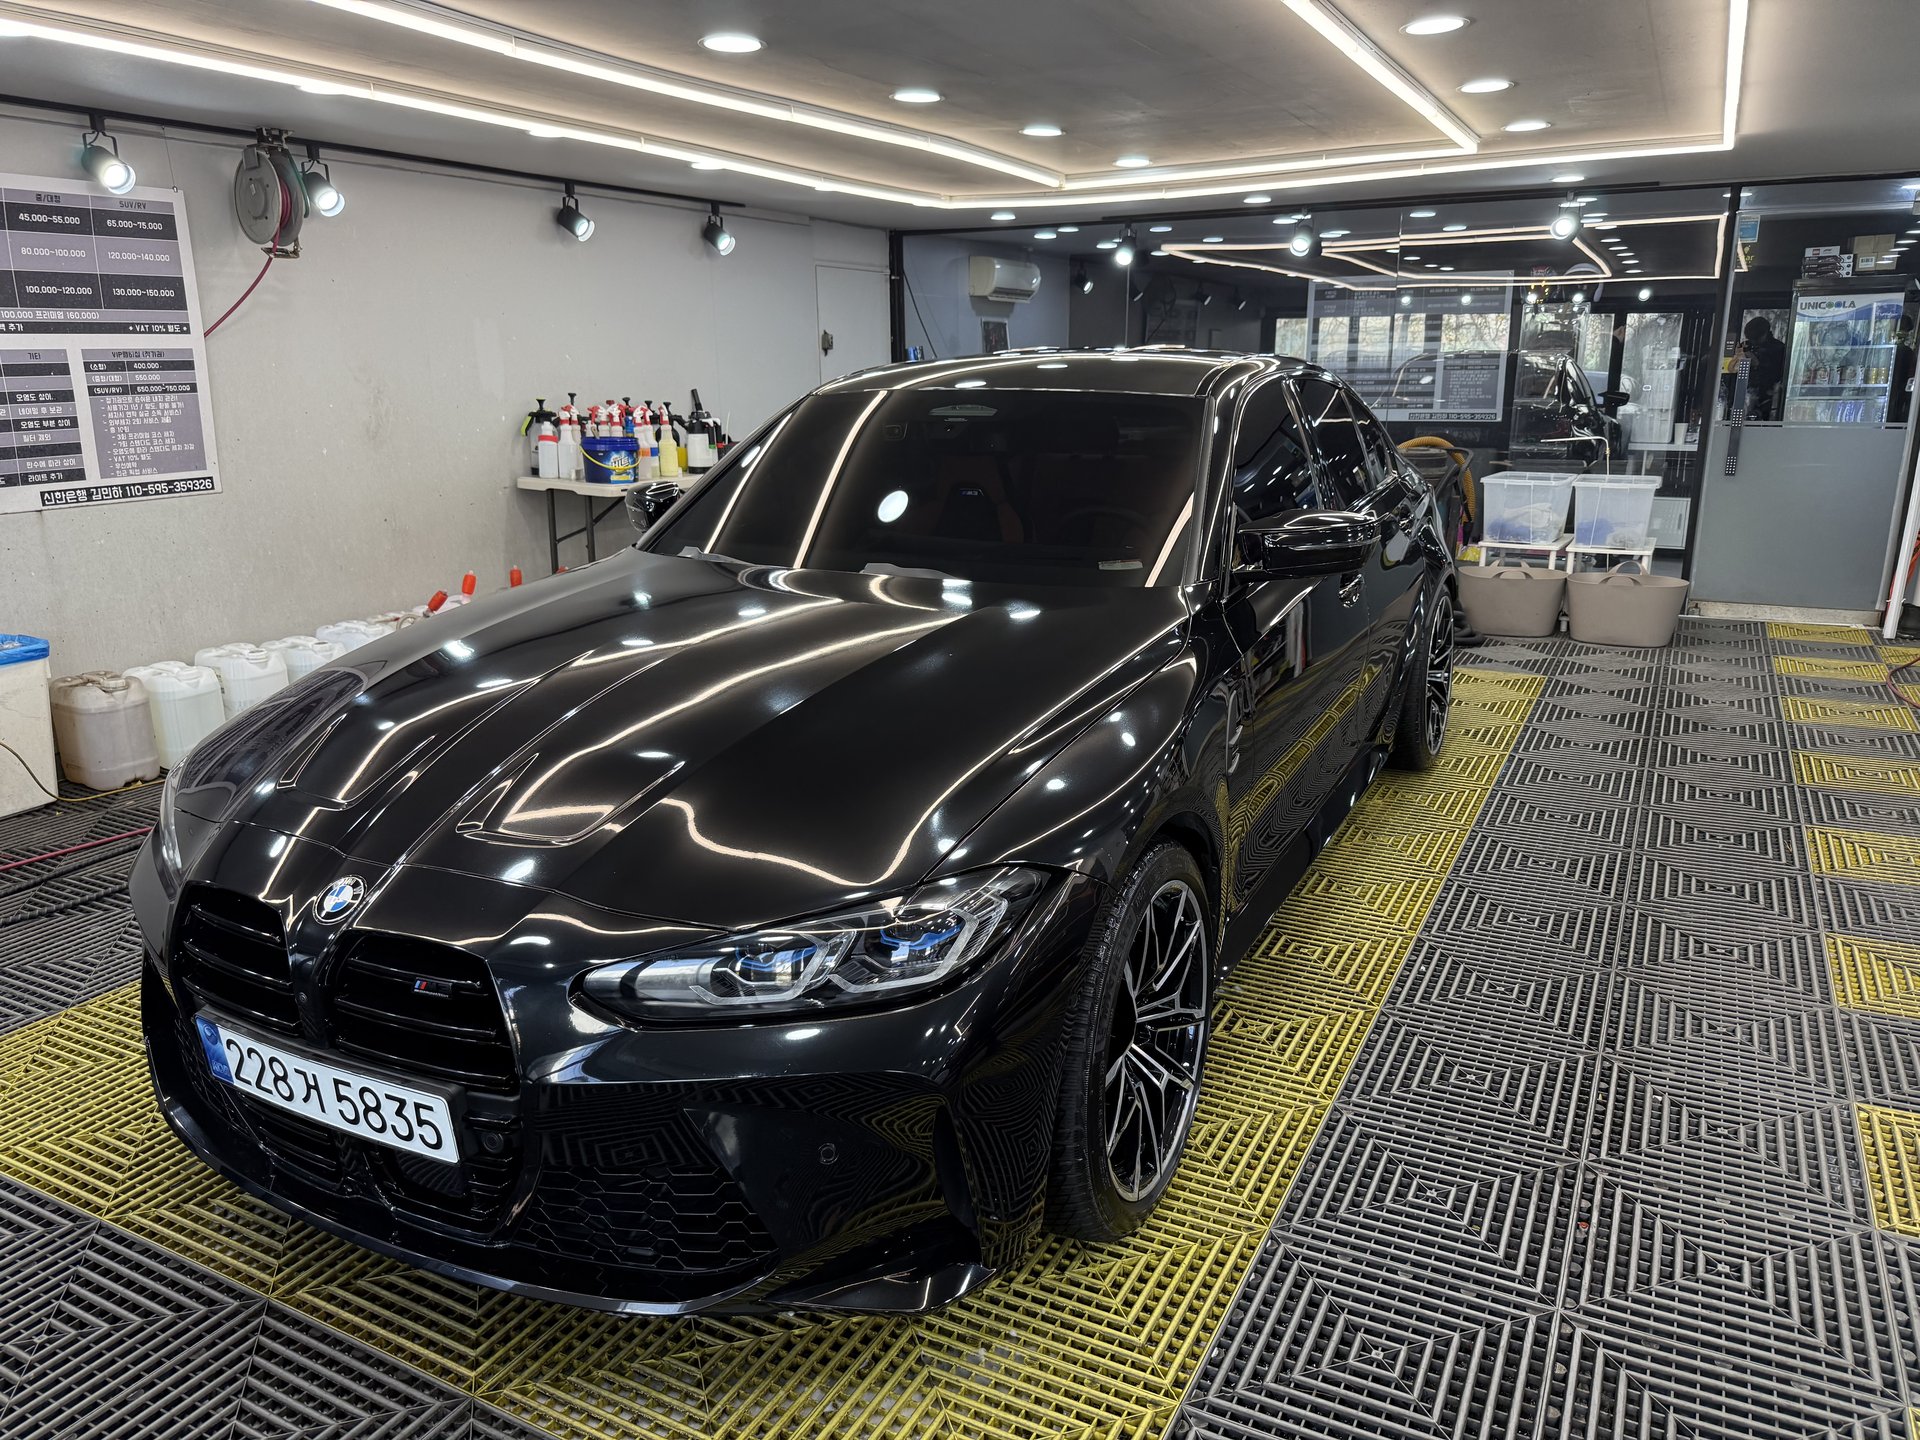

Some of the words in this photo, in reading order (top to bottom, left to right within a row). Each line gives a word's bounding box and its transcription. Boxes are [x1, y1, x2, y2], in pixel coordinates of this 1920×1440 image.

[119, 201, 147, 210] SUV/RV
[19, 212, 80, 225] 45.000~55.000
[107, 219, 163, 230] 65.000~75.000
[21, 247, 86, 257] 80.000~100.000
[108, 252, 170, 262] 120.000~140.000
[25, 285, 93, 295] 100.000~120.000
[35, 311, 64, 320] 프리미엄
[66, 311, 100, 320] 160.000)
[8, 323, 24, 332] 추가
[135, 324, 149, 332] VAT
[167, 324, 181, 333] 별도
[16, 393, 37, 402] 오염도
[49, 406, 63, 414] 보관
[21, 421, 41, 429] 오염도
[50, 473, 63, 481] 추가
[44, 490, 87, 505] 신한은행
[91, 487, 123, 500] 김민하
[126, 479, 212, 495] 110-595-359326
[226, 1037, 326, 1114] 228거
[332, 1077, 443, 1150] 5835
